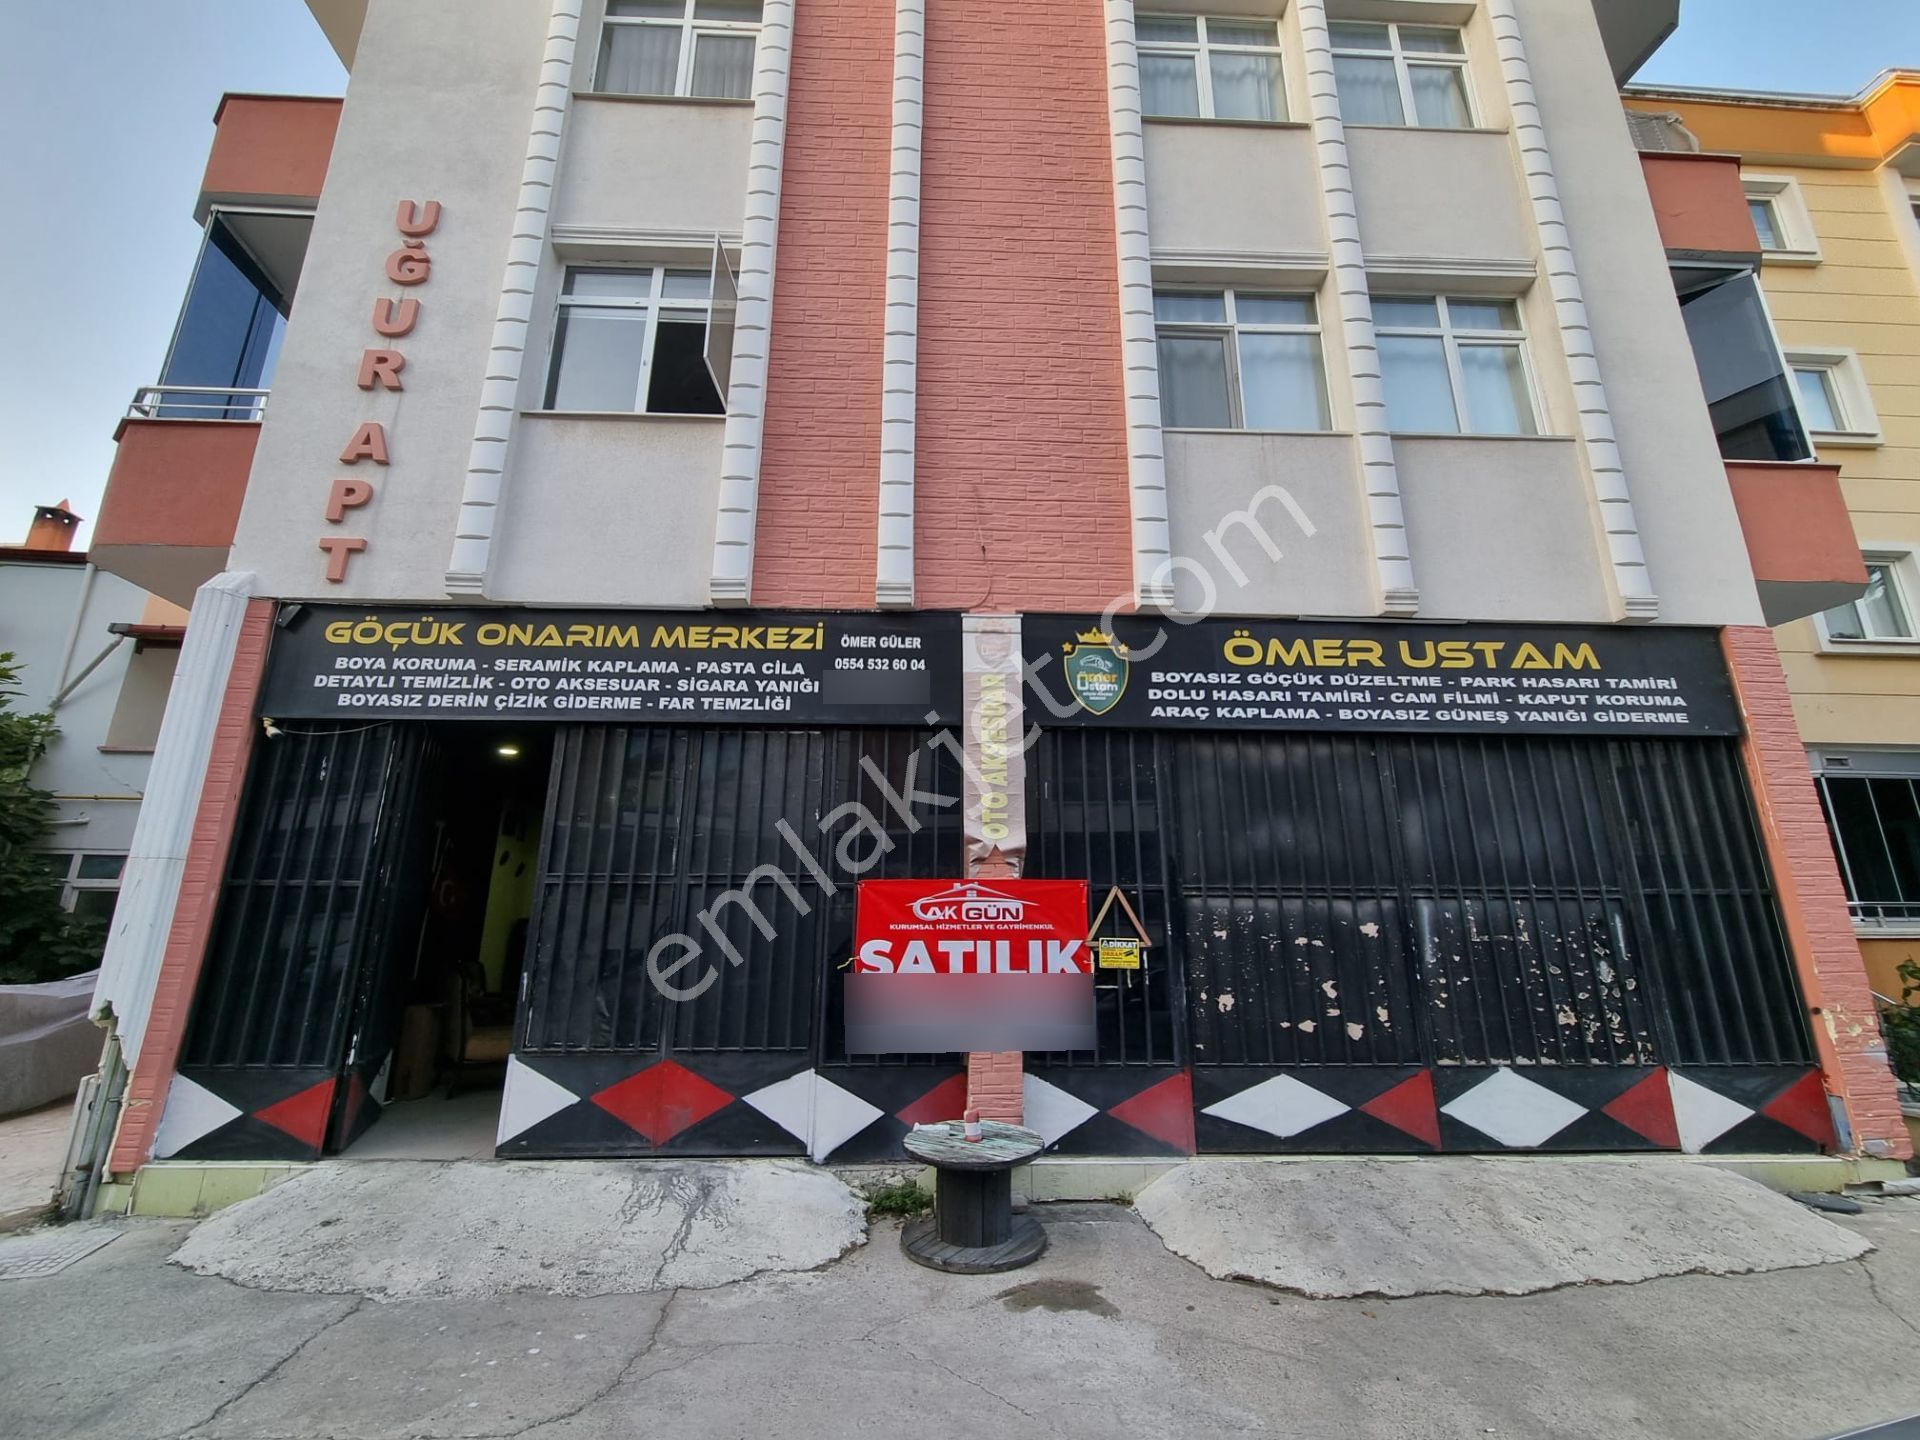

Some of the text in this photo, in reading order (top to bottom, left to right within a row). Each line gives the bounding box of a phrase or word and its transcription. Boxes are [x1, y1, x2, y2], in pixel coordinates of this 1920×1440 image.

[319, 200, 442, 583] UĞUR APT
[324, 616, 824, 651] GÖÇÜK ONARIM MERKEZİ
[840, 634, 922, 650] ÖMER GÜLER
[1223, 629, 1602, 670] ÖMER USTAM
[335, 656, 387, 670] BOYA
[392, 657, 476, 671] KORUMA
[494, 656, 581, 673] SERAMİK
[587, 660, 679, 674] KAPLAMA
[696, 661, 756, 675] PASTA
[761, 660, 805, 675] CİLA
[834, 658, 926, 672] 0554 532 60 04
[314, 675, 394, 689] DETAYLI
[401, 674, 493, 690] TEMİZLİK
[510, 678, 550, 690] OTO
[555, 678, 660, 692] AKSESUAR
[677, 676, 749, 692] SİGARA
[755, 677, 819, 693] YANIĞI
[1151, 671, 1241, 684] BOYASIZ
[1247, 670, 1324, 688] GÖÇÜK
[1329, 671, 1442, 687] DÜZELTME
[1460, 677, 1517, 688] PARK
[1522, 677, 1600, 689] HASARI
[1605, 676, 1677, 690] TAMİRİ
[337, 693, 422, 708] BOYASIZ
[427, 693, 489, 708] DERİN
[494, 693, 547, 711] ÇİZİK
[553, 693, 642, 710] GİDERME
[658, 697, 695, 710] FAR
[700, 694, 791, 711] TEMZLİĞİ
[1148, 688, 1205, 700] DOLU
[1211, 689, 1291, 702] HASARI
[1297, 688, 1371, 703] TAMİRİ
[1390, 692, 1437, 704] CAM
[1443, 691, 1499, 705] FİLMİ
[1518, 694, 1589, 706] KAPUT
[1595, 695, 1687, 707] KORUMA
[1150, 705, 1210, 720] ARAÇ
[1216, 707, 1320, 720] KAPLAMA
[1339, 708, 1430, 721] BOYASIZ
[1435, 707, 1509, 724] GÜNEŞ
[1514, 708, 1587, 723] YANIĞI
[1593, 709, 1689, 724] GİDERME
[980, 673, 1009, 840] OTO AKSESUAR
[965, 904, 1020, 920] GÜN
[936, 922, 982, 930] HİZMETLER
[996, 922, 1055, 930] GAYRİMENKUL
[859, 939, 1083, 973] SATILIK
